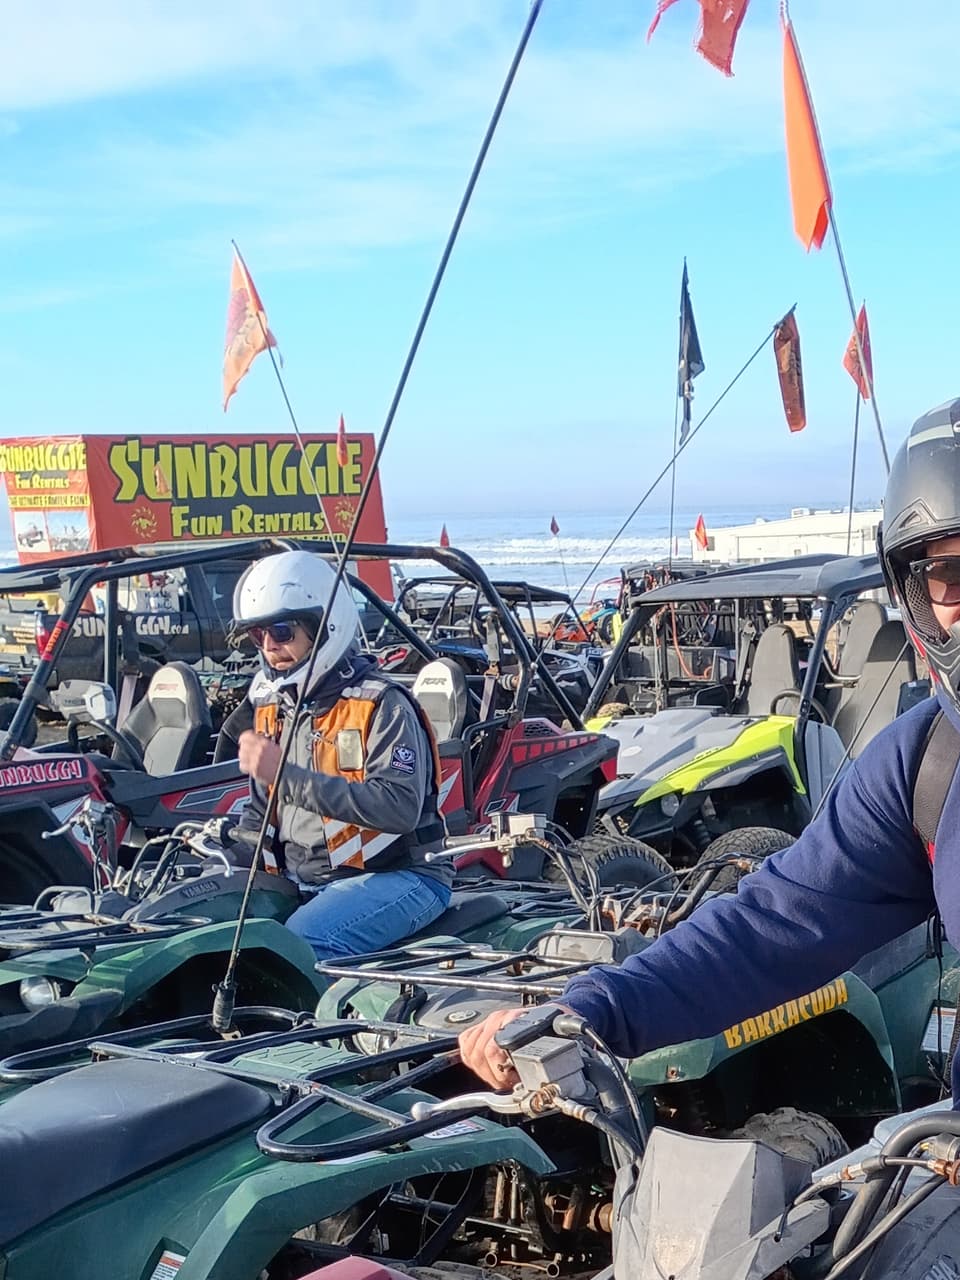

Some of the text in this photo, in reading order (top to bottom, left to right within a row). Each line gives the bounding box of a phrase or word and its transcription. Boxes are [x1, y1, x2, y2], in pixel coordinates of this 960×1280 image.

[108, 439, 363, 502] SUNBUGGIE
[170, 504, 325, 538] FUN RENTALS
[0, 759, 82, 787] NBUGGY
